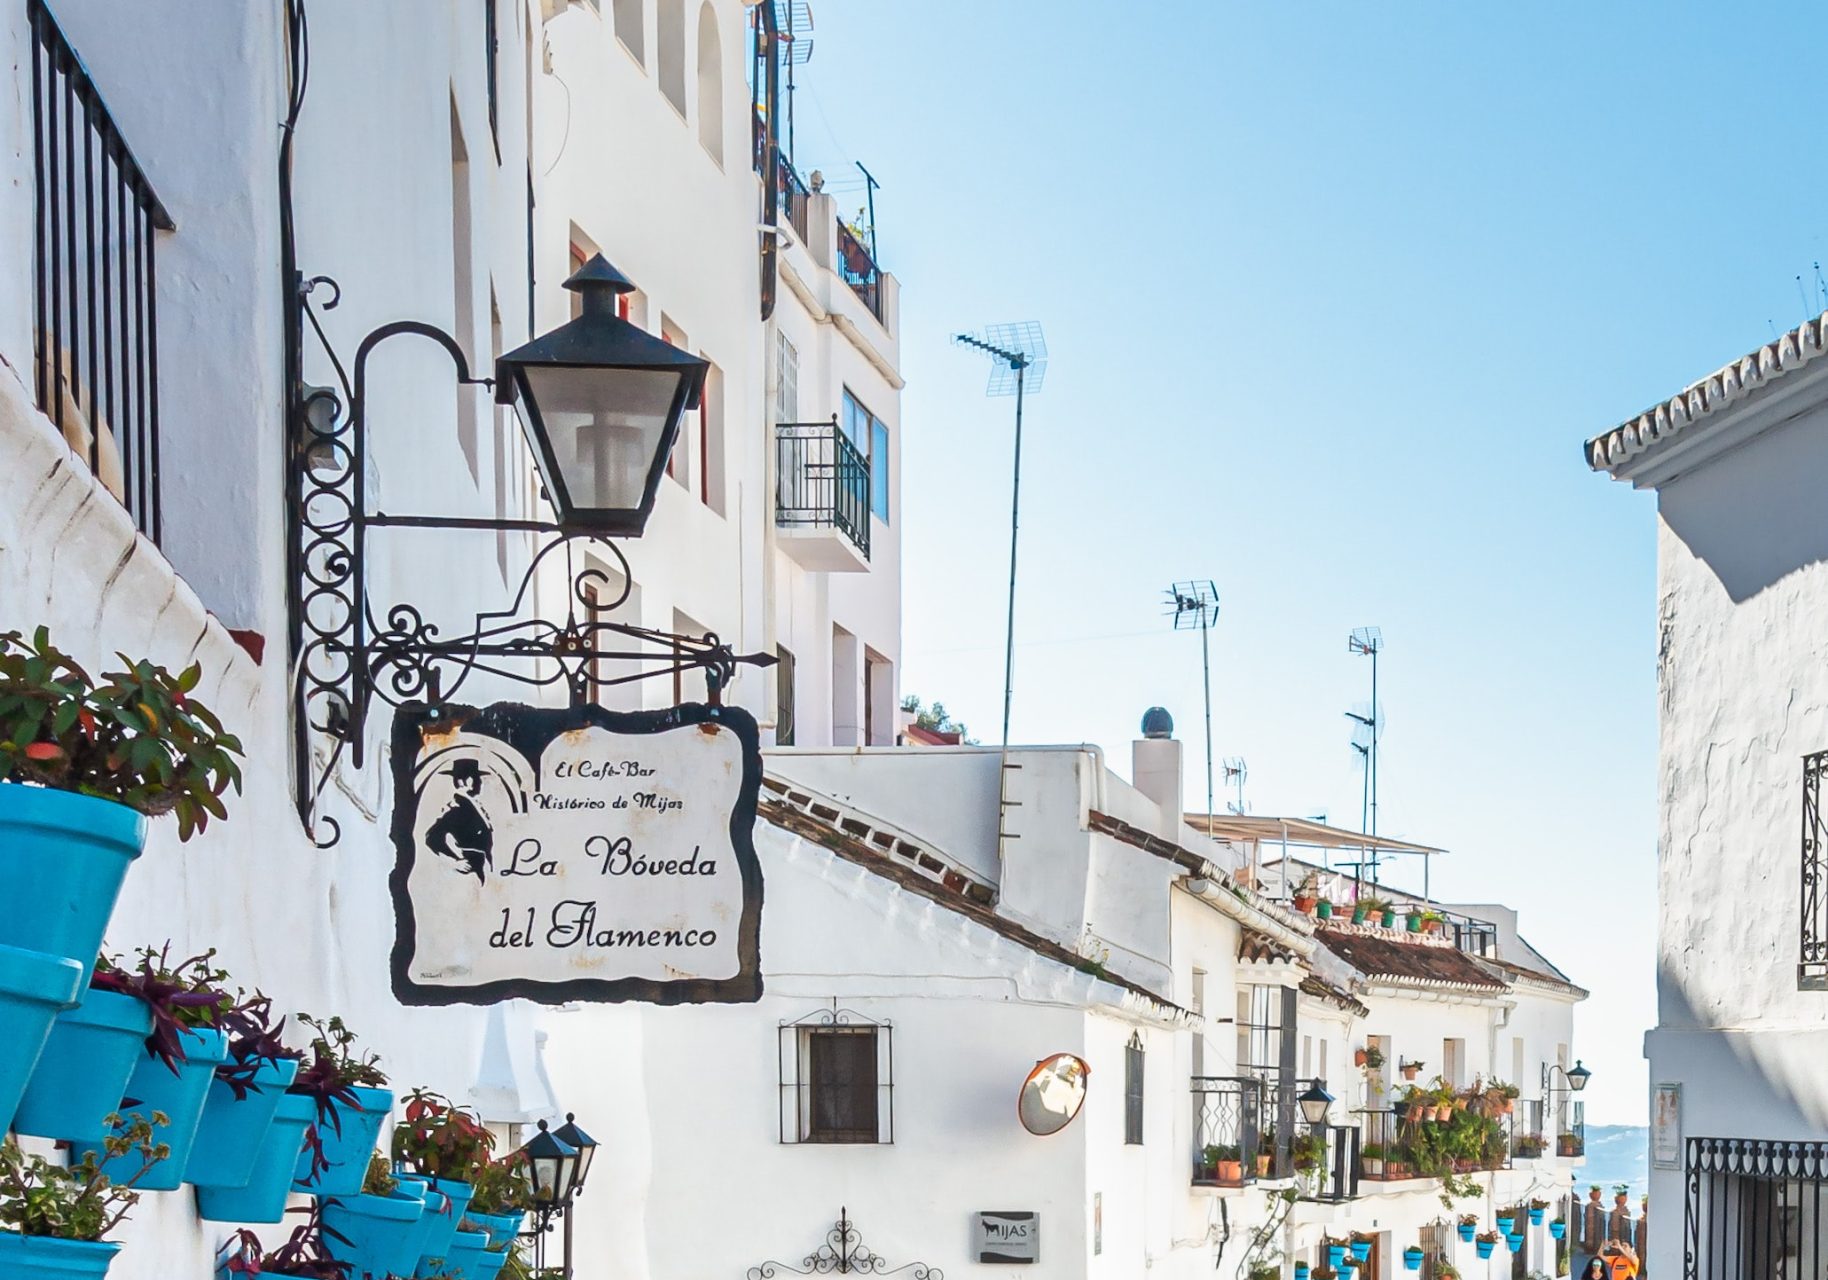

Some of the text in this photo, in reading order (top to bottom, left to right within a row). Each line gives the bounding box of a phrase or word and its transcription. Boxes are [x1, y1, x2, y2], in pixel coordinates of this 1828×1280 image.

[554, 761, 573, 778] El
[532, 791, 684, 814] Histórico de Mijas
[500, 835, 717, 877] La Bóveda
[489, 899, 718, 949] del Flamenco
[982, 1219, 1027, 1240] MIJAS
